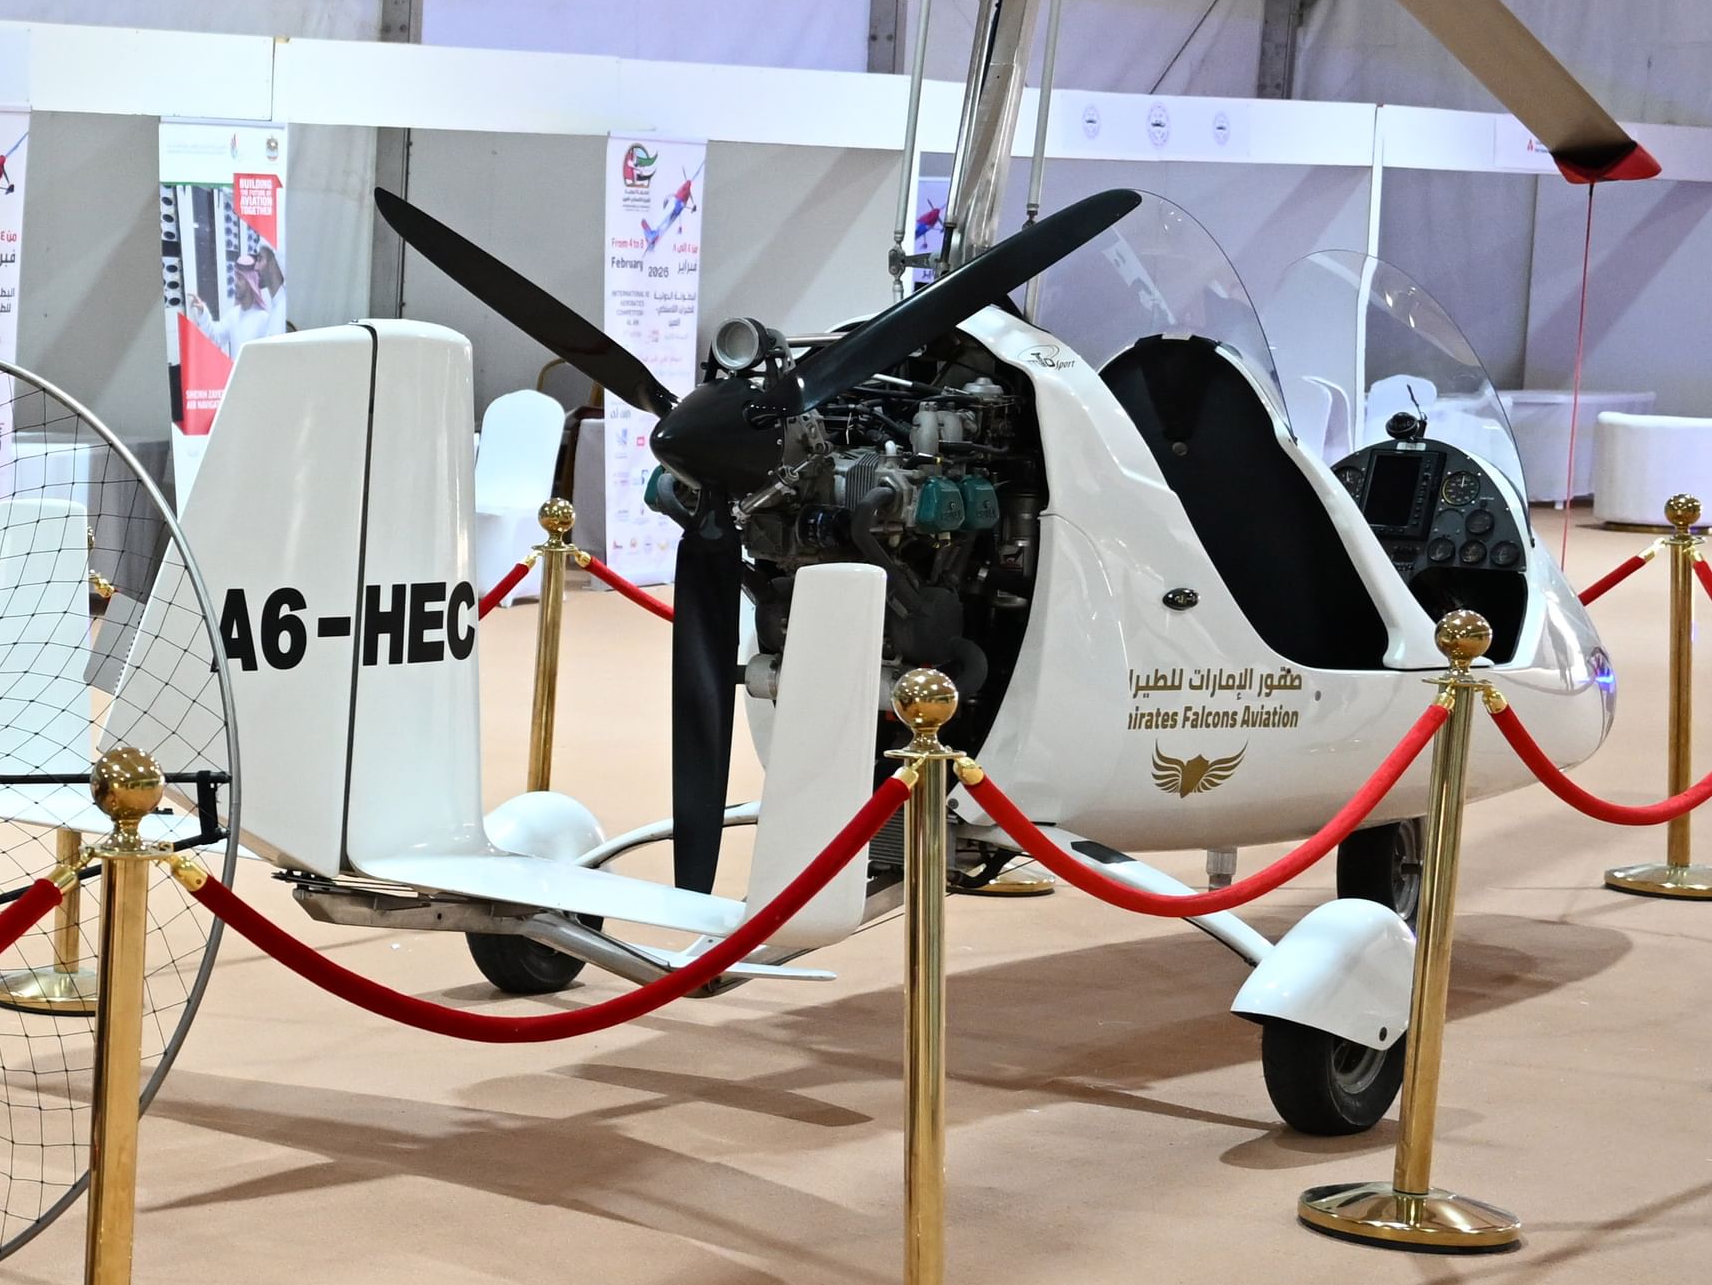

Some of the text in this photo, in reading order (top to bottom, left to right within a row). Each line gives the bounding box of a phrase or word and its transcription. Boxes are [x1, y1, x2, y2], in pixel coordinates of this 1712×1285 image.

[239, 178, 272, 188] BUILDING
[240, 196, 273, 206] AVIATION
[240, 206, 272, 215] TOGETHER
[8, 230, 17, 242] من
[611, 237, 628, 248] From
[611, 256, 669, 278] February 2026
[210, 580, 476, 672] A6-HEC
[1129, 667, 1303, 701] صقور الإمارات للطيرا
[1181, 705, 1238, 729] Falcons
[1240, 704, 1299, 728] Aviation
